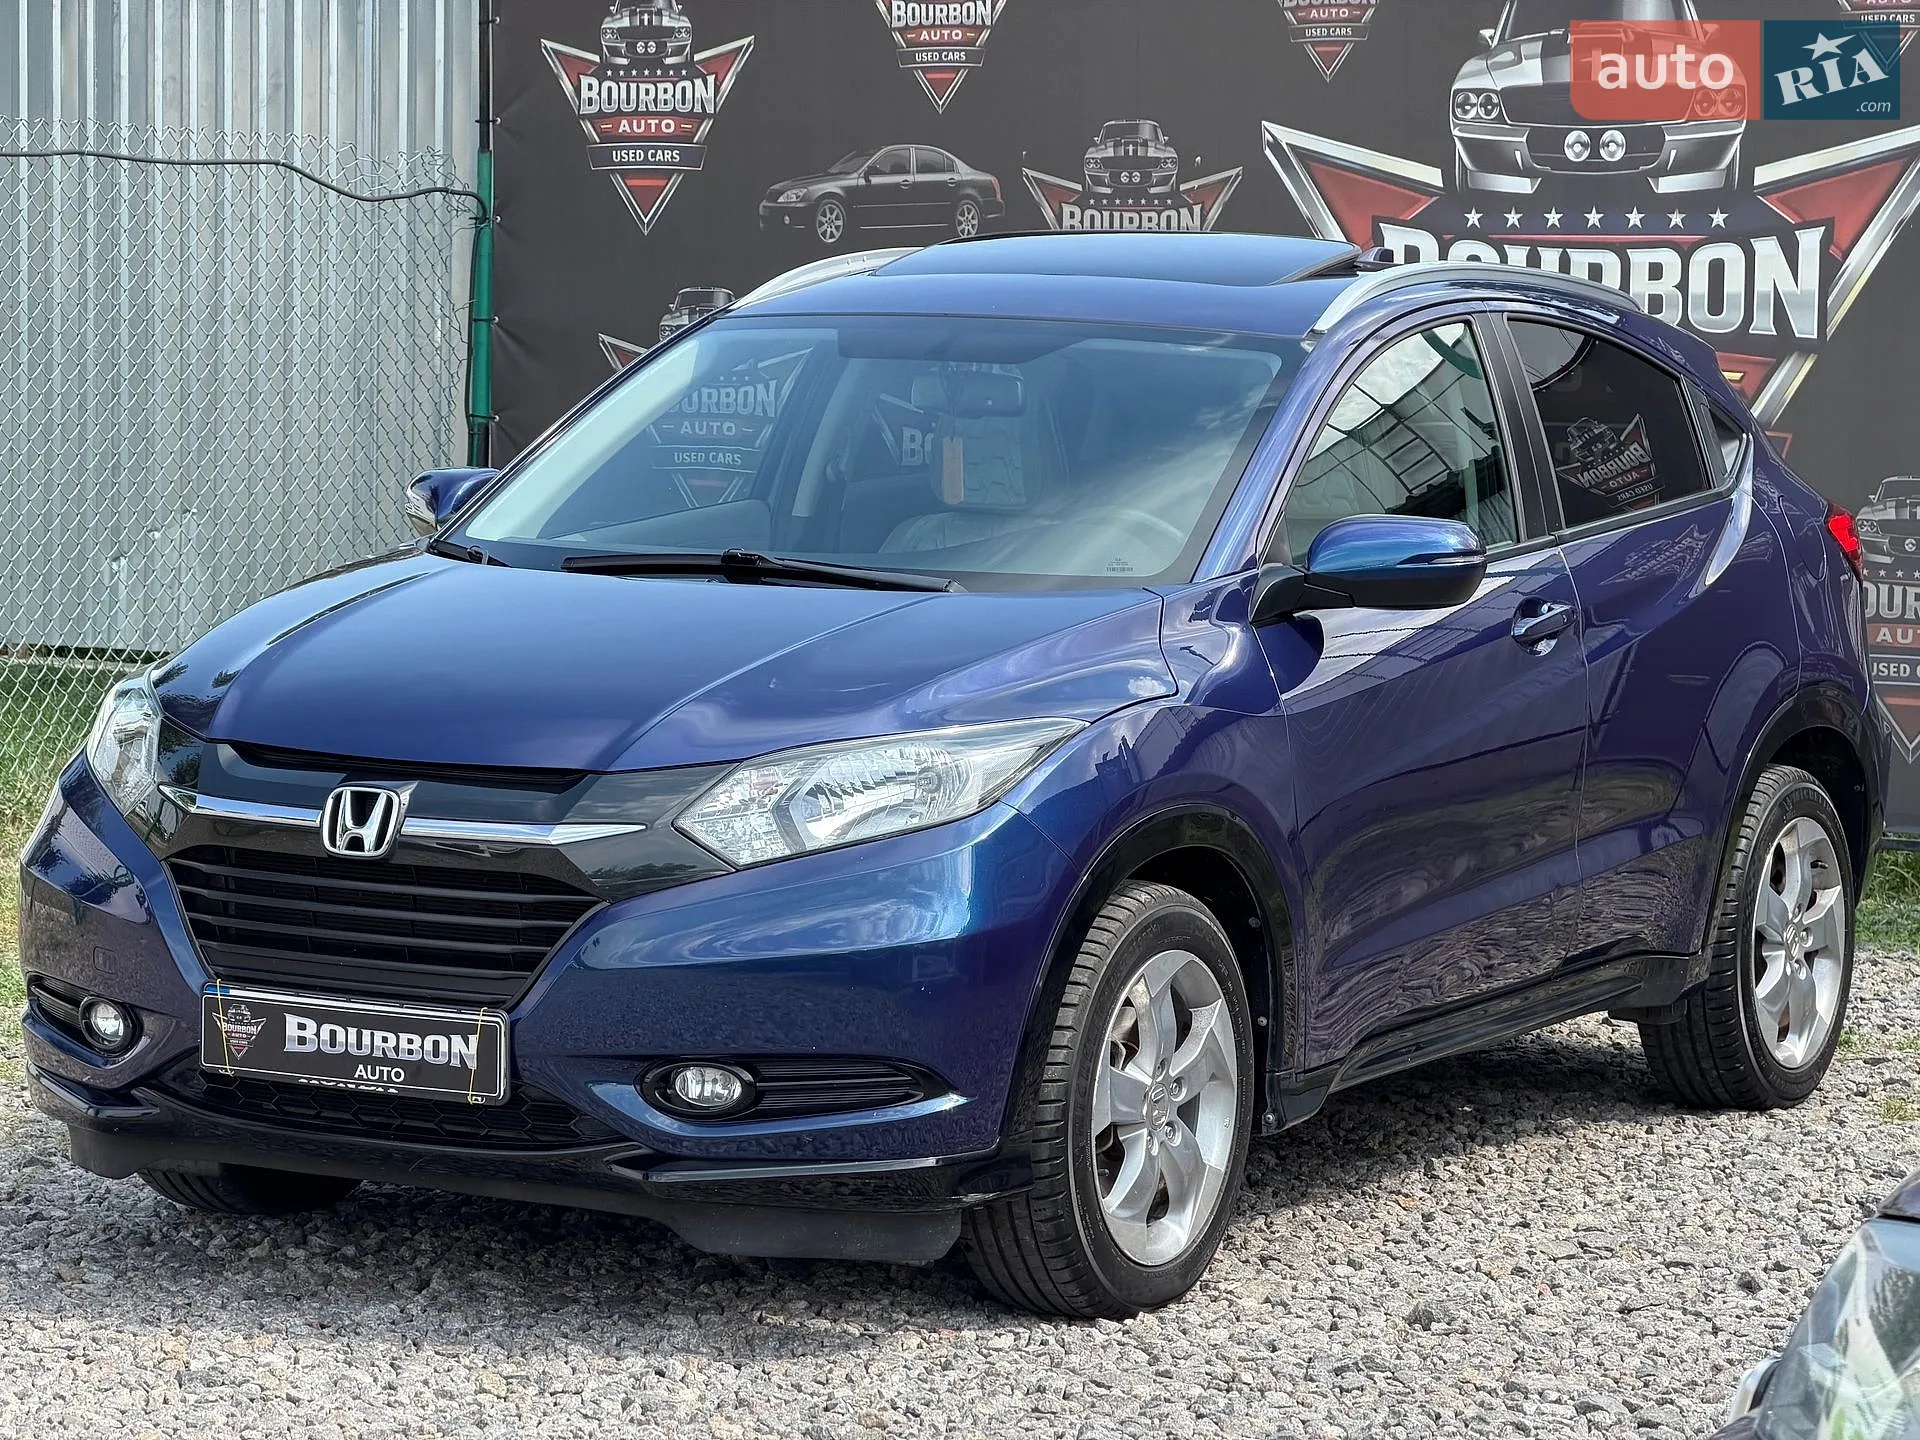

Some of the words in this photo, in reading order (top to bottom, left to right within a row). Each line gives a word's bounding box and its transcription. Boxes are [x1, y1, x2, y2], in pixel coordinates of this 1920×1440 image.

[892, 0, 991, 28] BOURBON
[1310, 8, 1348, 19] AUTO
[1889, 14, 1916, 23] CARS
[920, 30, 962, 40] AUTO
[1305, 28, 1328, 37] USED
[1330, 27, 1352, 36] CARS
[915, 52, 939, 62] USED
[941, 51, 966, 61] CARS
[579, 73, 716, 115] BOURBON
[618, 119, 675, 133] AUTO
[612, 149, 644, 162] USED
[647, 149, 680, 162] CARS
[680, 420, 736, 436] AUTO
[674, 451, 706, 464] USED
[708, 452, 742, 465] CARS
[283, 1012, 478, 1070] BOURBON
[354, 1063, 405, 1083] AUTO
